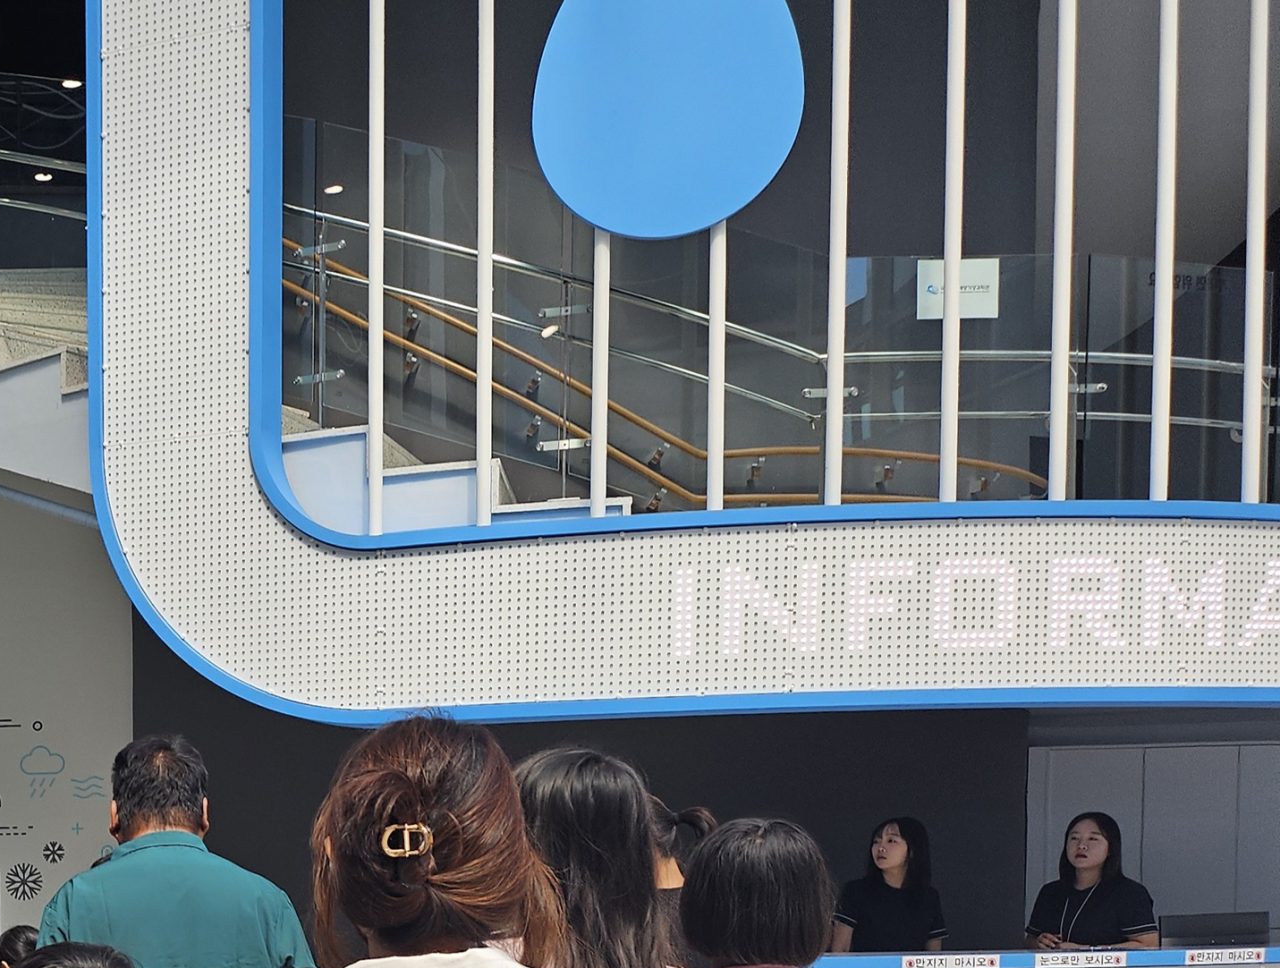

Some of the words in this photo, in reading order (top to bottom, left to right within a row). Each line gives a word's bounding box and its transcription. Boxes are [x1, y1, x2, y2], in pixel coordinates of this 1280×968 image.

[915, 957, 948, 968] 만지지
[954, 956, 987, 967] 마시오
[1040, 955, 1080, 966] 눈으로만
[1085, 954, 1114, 965] 보시오
[1196, 951, 1224, 962] 만지지
[1228, 950, 1254, 961] 마시오
